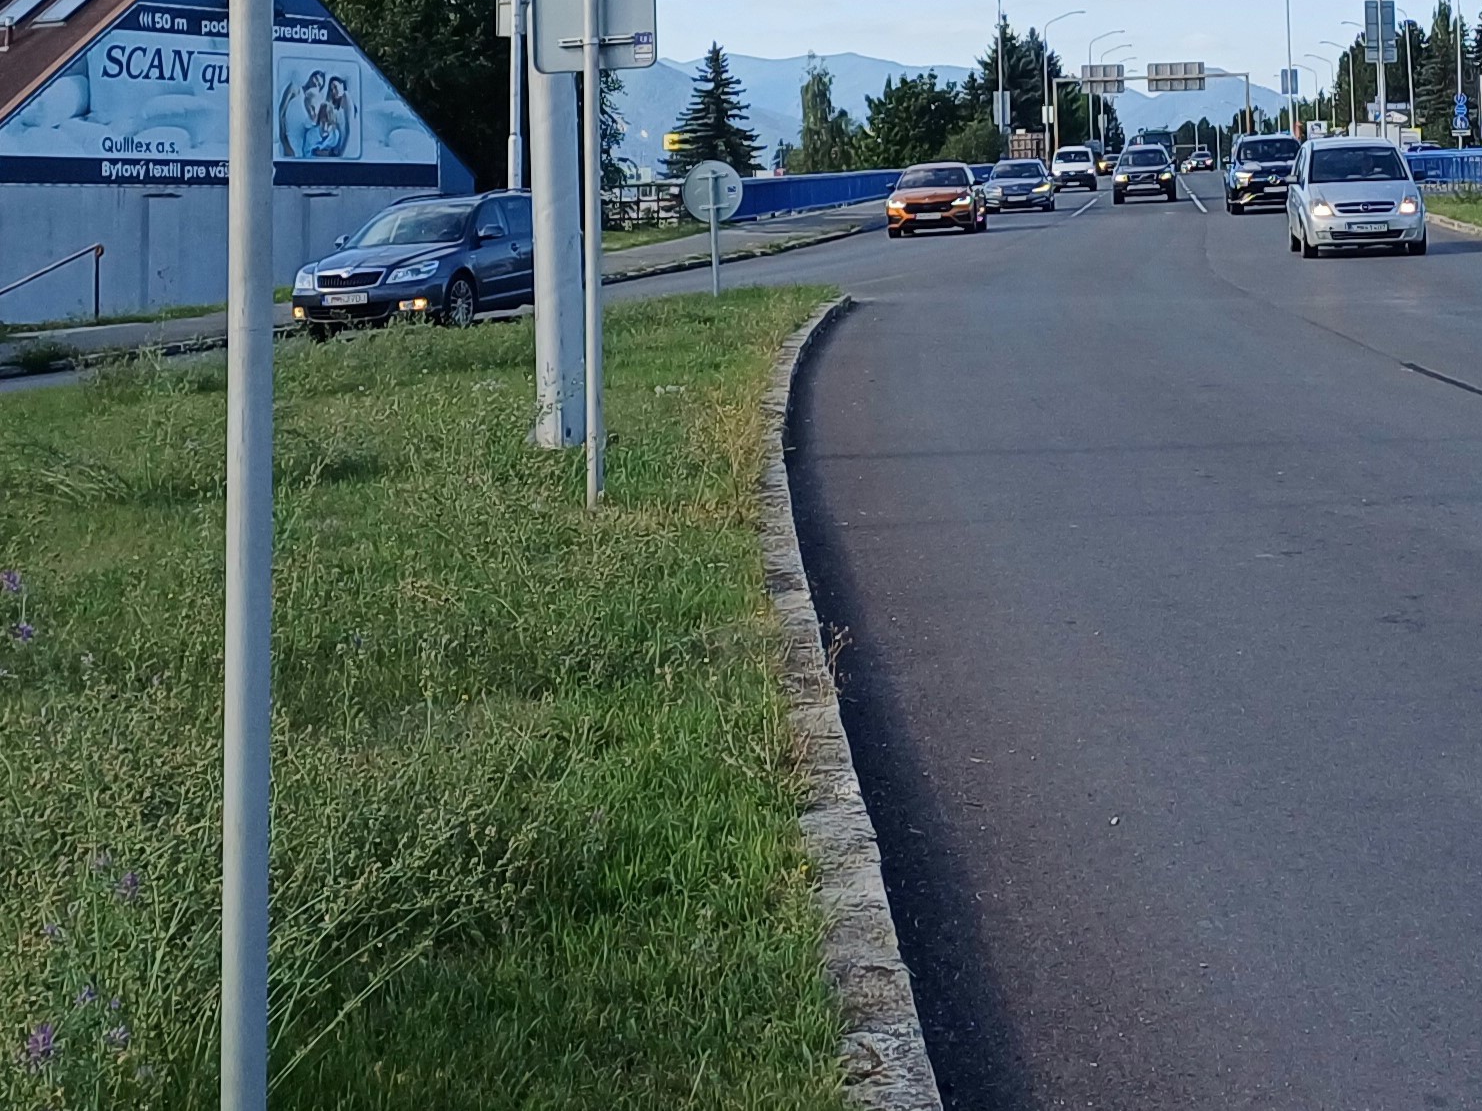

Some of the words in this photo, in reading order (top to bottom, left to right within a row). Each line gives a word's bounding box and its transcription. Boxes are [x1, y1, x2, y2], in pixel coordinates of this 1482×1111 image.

[154, 12, 171, 29] 50
[174, 17, 187, 32] m
[101, 44, 196, 83] SCAN
[184, 165, 206, 181] pre
